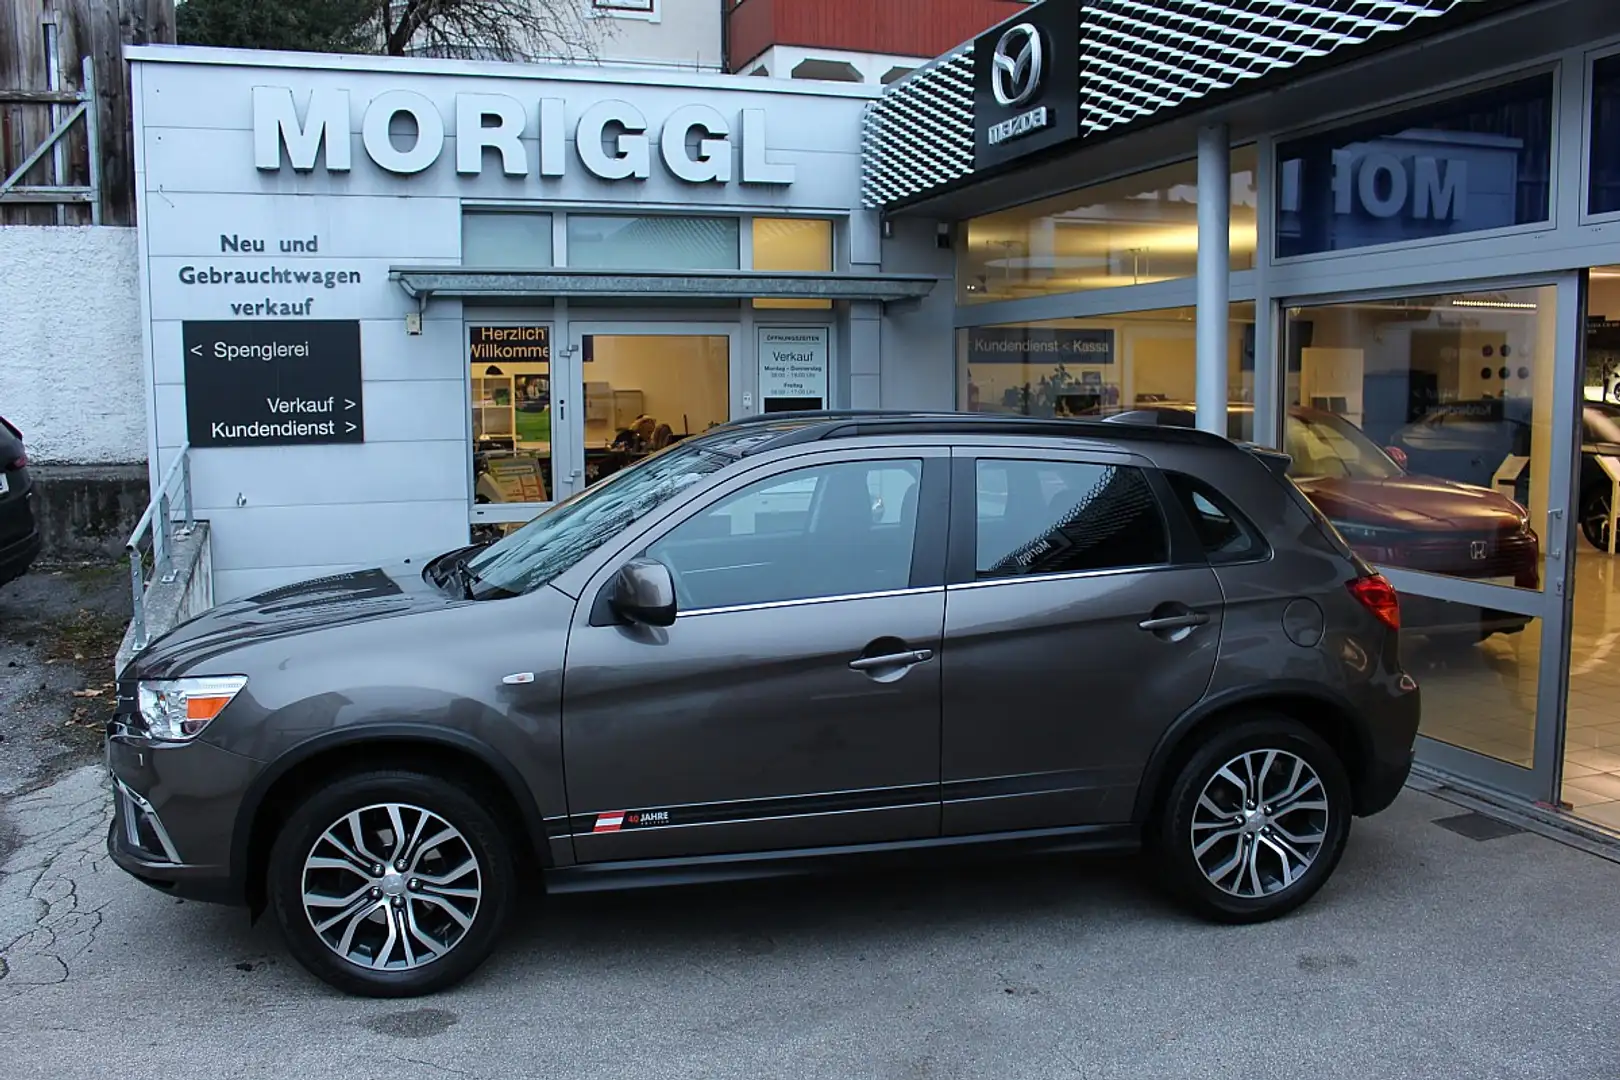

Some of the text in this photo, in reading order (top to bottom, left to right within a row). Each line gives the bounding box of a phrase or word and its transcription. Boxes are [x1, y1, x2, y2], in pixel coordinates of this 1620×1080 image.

[252, 85, 797, 187] MORIGGL
[220, 234, 318, 253] Neu und
[178, 265, 362, 289] Gebrauchtwagen
[230, 297, 314, 316] verkauf
[481, 326, 545, 341] Herzlich
[213, 340, 310, 361] Spenglerei
[974, 337, 1110, 353] Kundendienst Kassa
[772, 351, 814, 362] Verkauf
[266, 396, 334, 414] Verkauf
[211, 418, 335, 438] Kundendienst
[627, 811, 669, 824] 40 JAHRE
